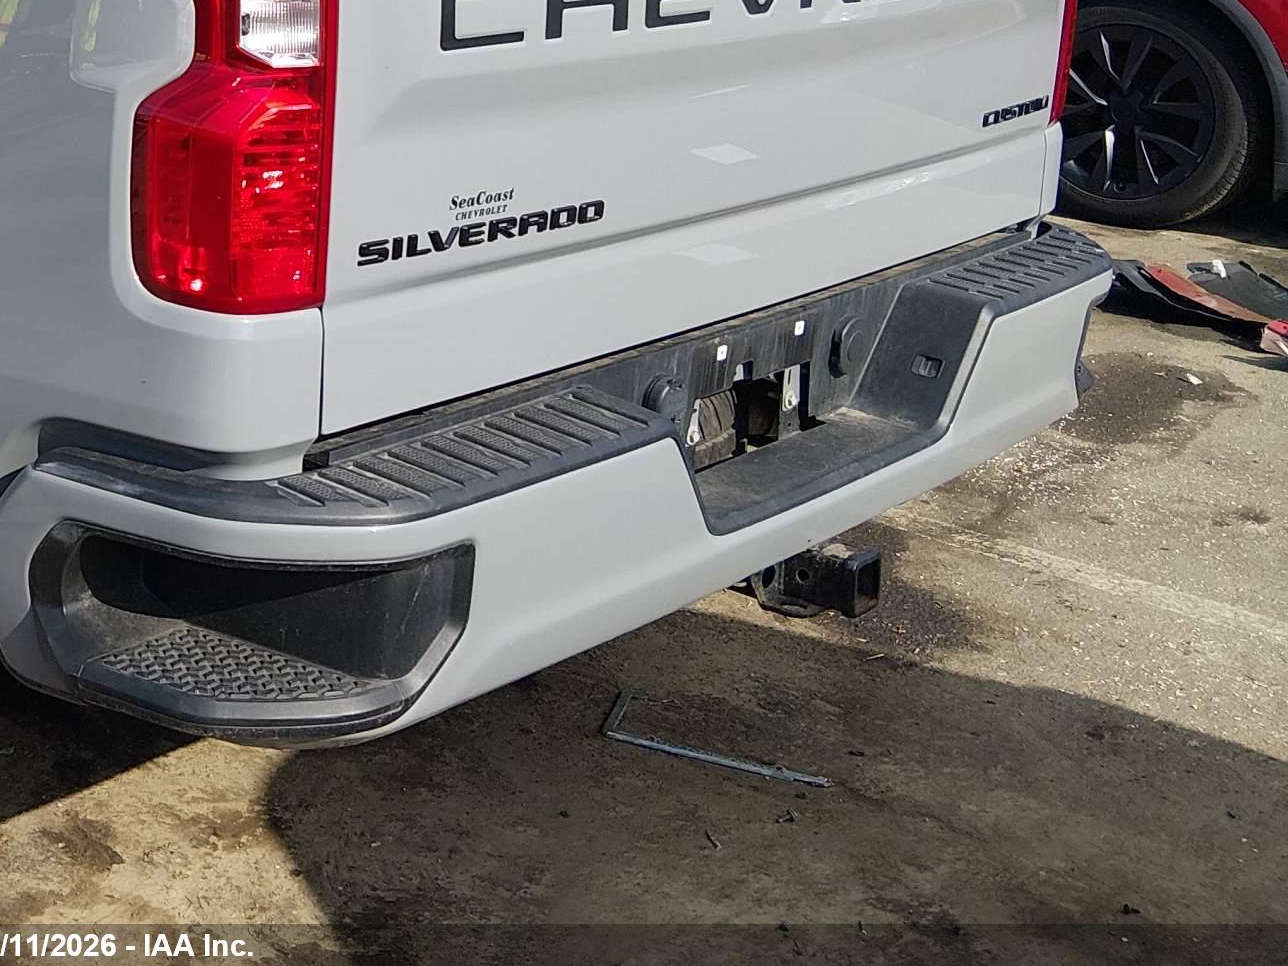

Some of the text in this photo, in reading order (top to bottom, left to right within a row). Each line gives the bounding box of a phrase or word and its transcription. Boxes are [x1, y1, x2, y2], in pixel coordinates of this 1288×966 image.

[449, 186, 515, 211] SeaCoast
[455, 204, 508, 221] CHEVROLET
[357, 199, 605, 267] SILVERADO
